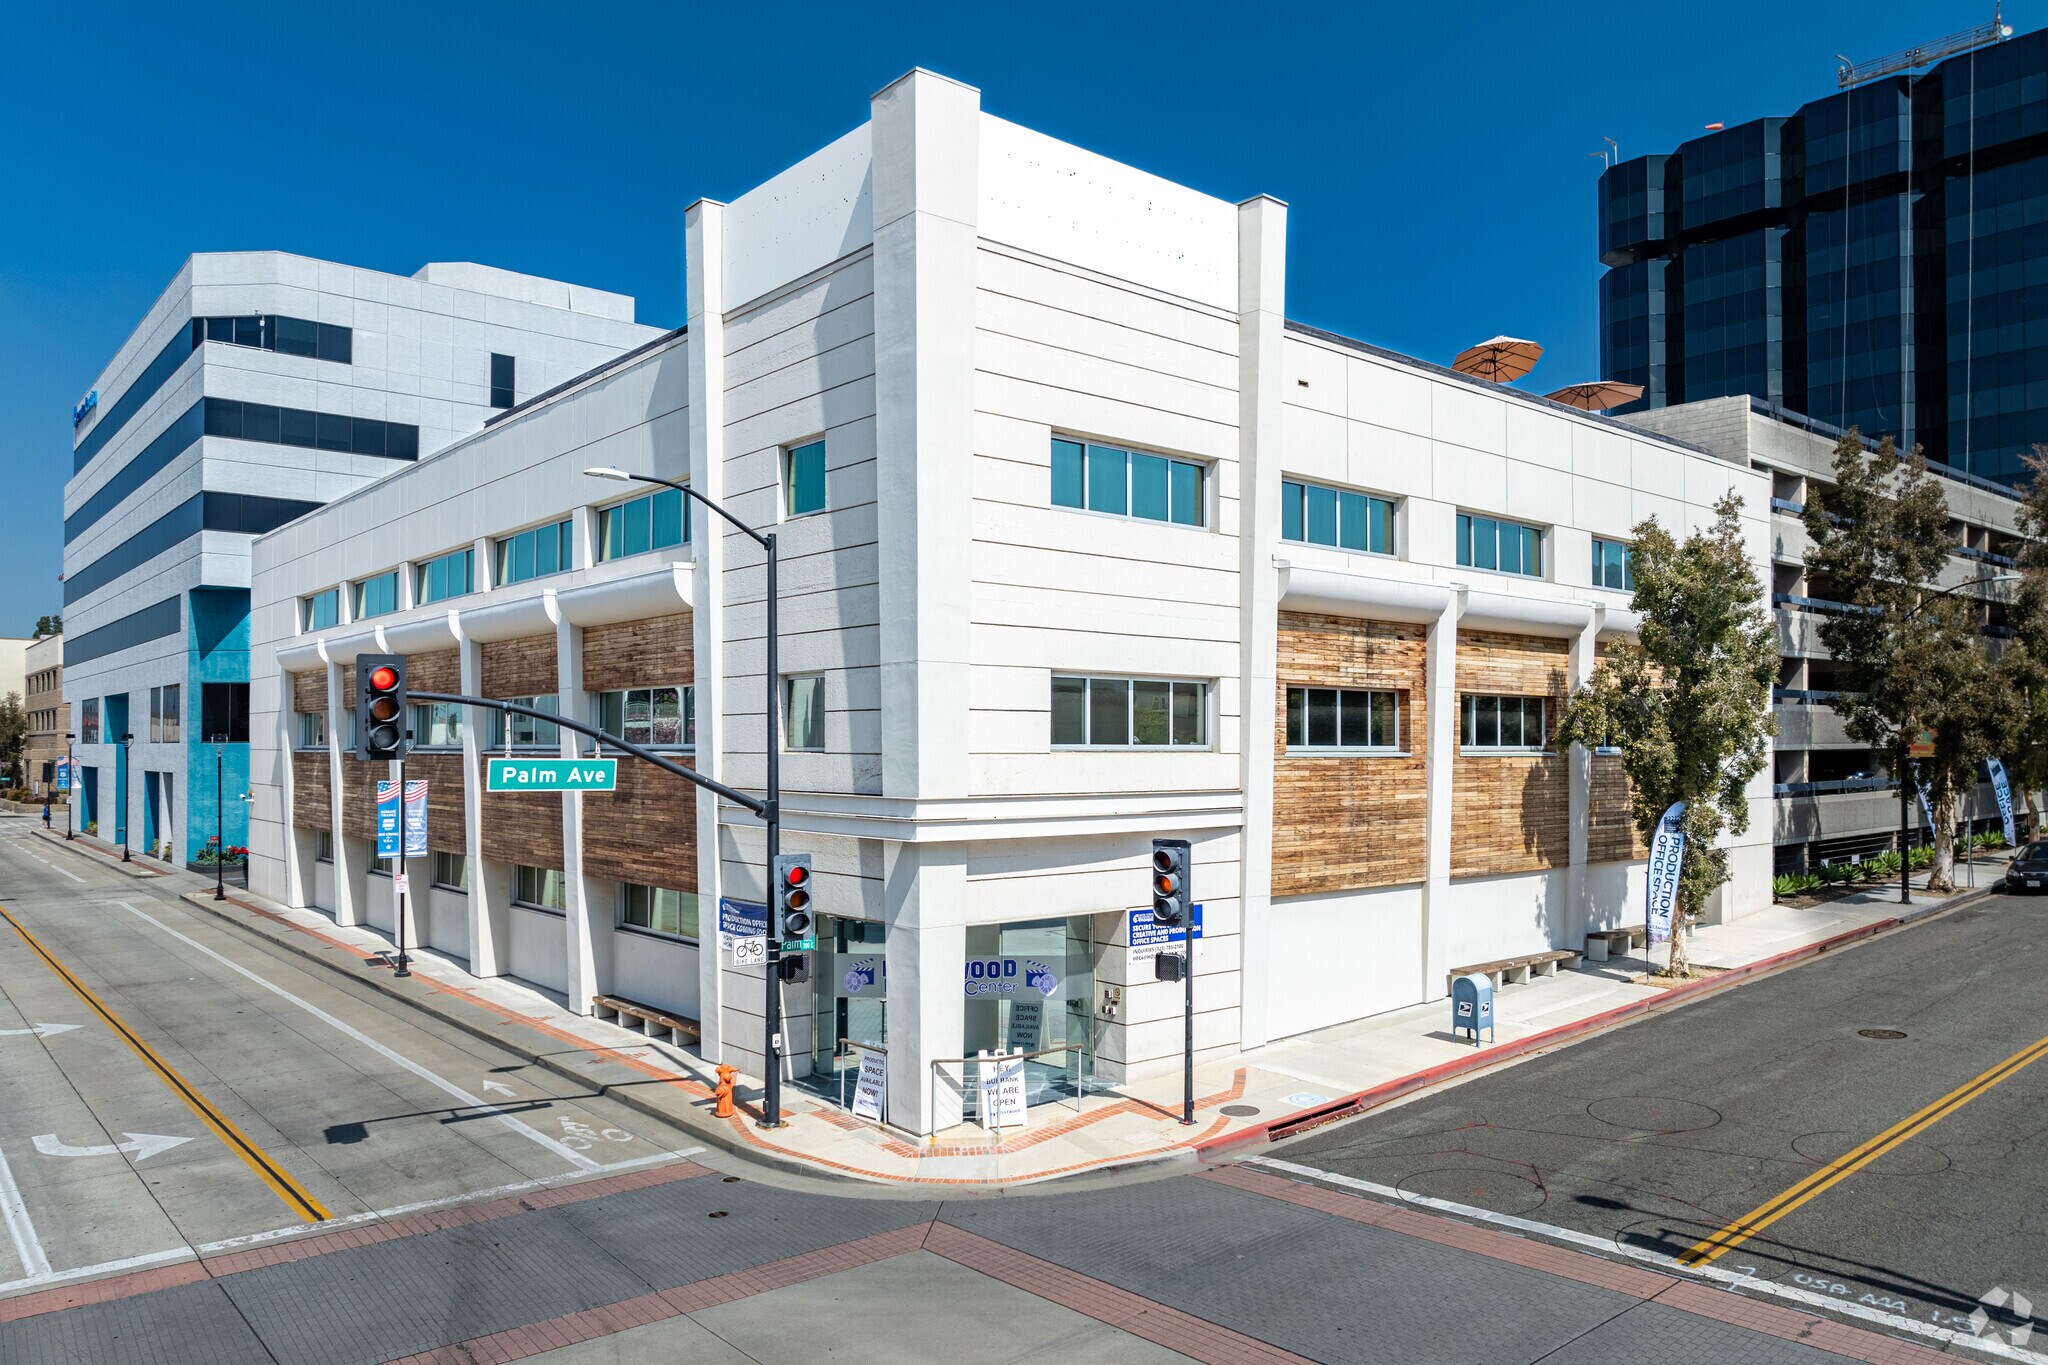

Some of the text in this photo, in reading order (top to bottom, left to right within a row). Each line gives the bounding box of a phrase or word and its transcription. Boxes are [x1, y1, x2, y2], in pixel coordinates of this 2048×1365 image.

[502, 766, 606, 783] Palm Ave
[1995, 783, 2010, 825] OFFICE
[1653, 834, 1668, 876] OFFICE
[1660, 836, 1680, 918] PRODUCTION
[1651, 876, 1662, 915] SPACE
[722, 913, 752, 926] PRODUCTION
[722, 921, 736, 931] SPACE
[736, 924, 756, 934] COMING
[1132, 924, 1152, 932] SECURE
[1132, 930, 1157, 938] CREATIVE
[782, 940, 802, 950] Palm
[1132, 935, 1168, 946] OFFICE SPACES
[964, 980, 1018, 996] Center
[864, 1056, 884, 1066] PRODUCTIO
[864, 1066, 884, 1076] SPACE
[860, 1076, 884, 1087] AVAILABLE
[862, 1087, 878, 1098] NOW!
[1003, 1086, 1020, 1094] ARE
[993, 1098, 1016, 1106] OPEN
